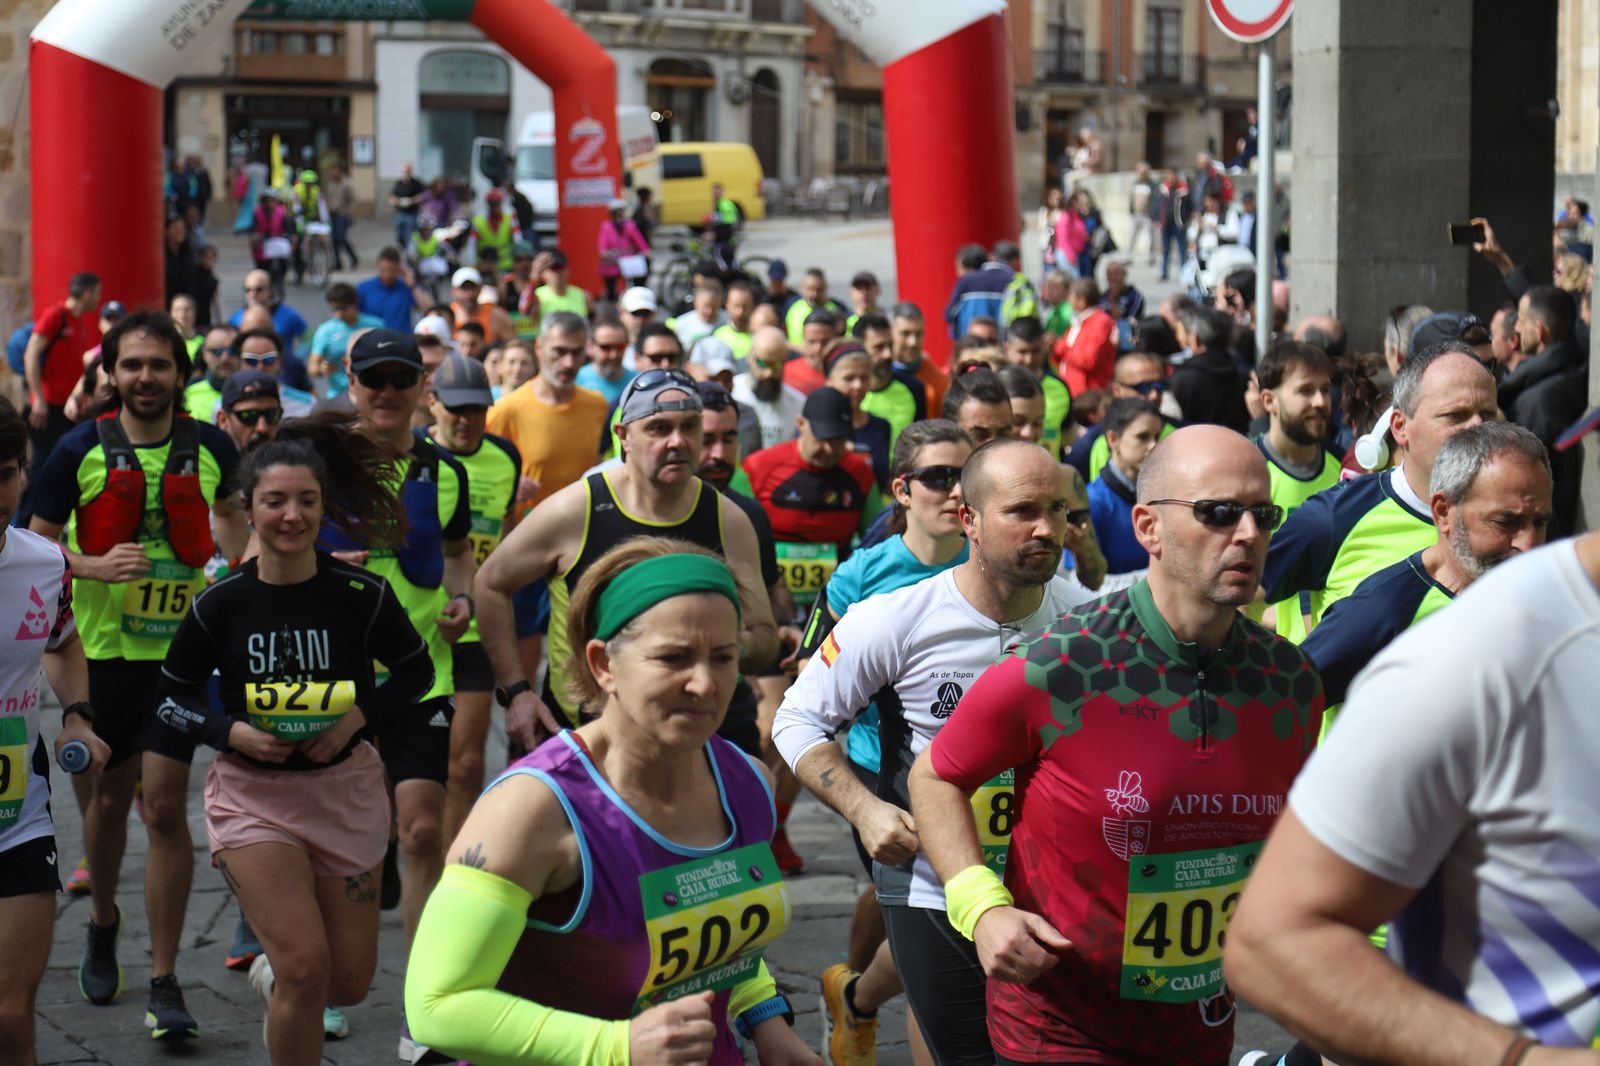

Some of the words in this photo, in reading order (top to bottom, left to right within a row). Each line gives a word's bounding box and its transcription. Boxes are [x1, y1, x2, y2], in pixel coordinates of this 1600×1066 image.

[138, 582, 189, 615] 115
[930, 671, 939, 679] As
[941, 671, 951, 679] de
[953, 671, 975, 680] Tapas
[255, 680, 338, 712] 527
[278, 722, 305, 733] CAJA
[1168, 794, 1223, 816] APIS
[679, 881, 707, 898] CAJA
[707, 871, 742, 890] RURAL
[1175, 867, 1200, 881] CAJA
[1203, 864, 1237, 878] RURAL
[653, 904, 770, 986] 502
[666, 980, 702, 1000] CAJA
[705, 958, 755, 987] RURAL
[1170, 973, 1207, 991] CAJA
